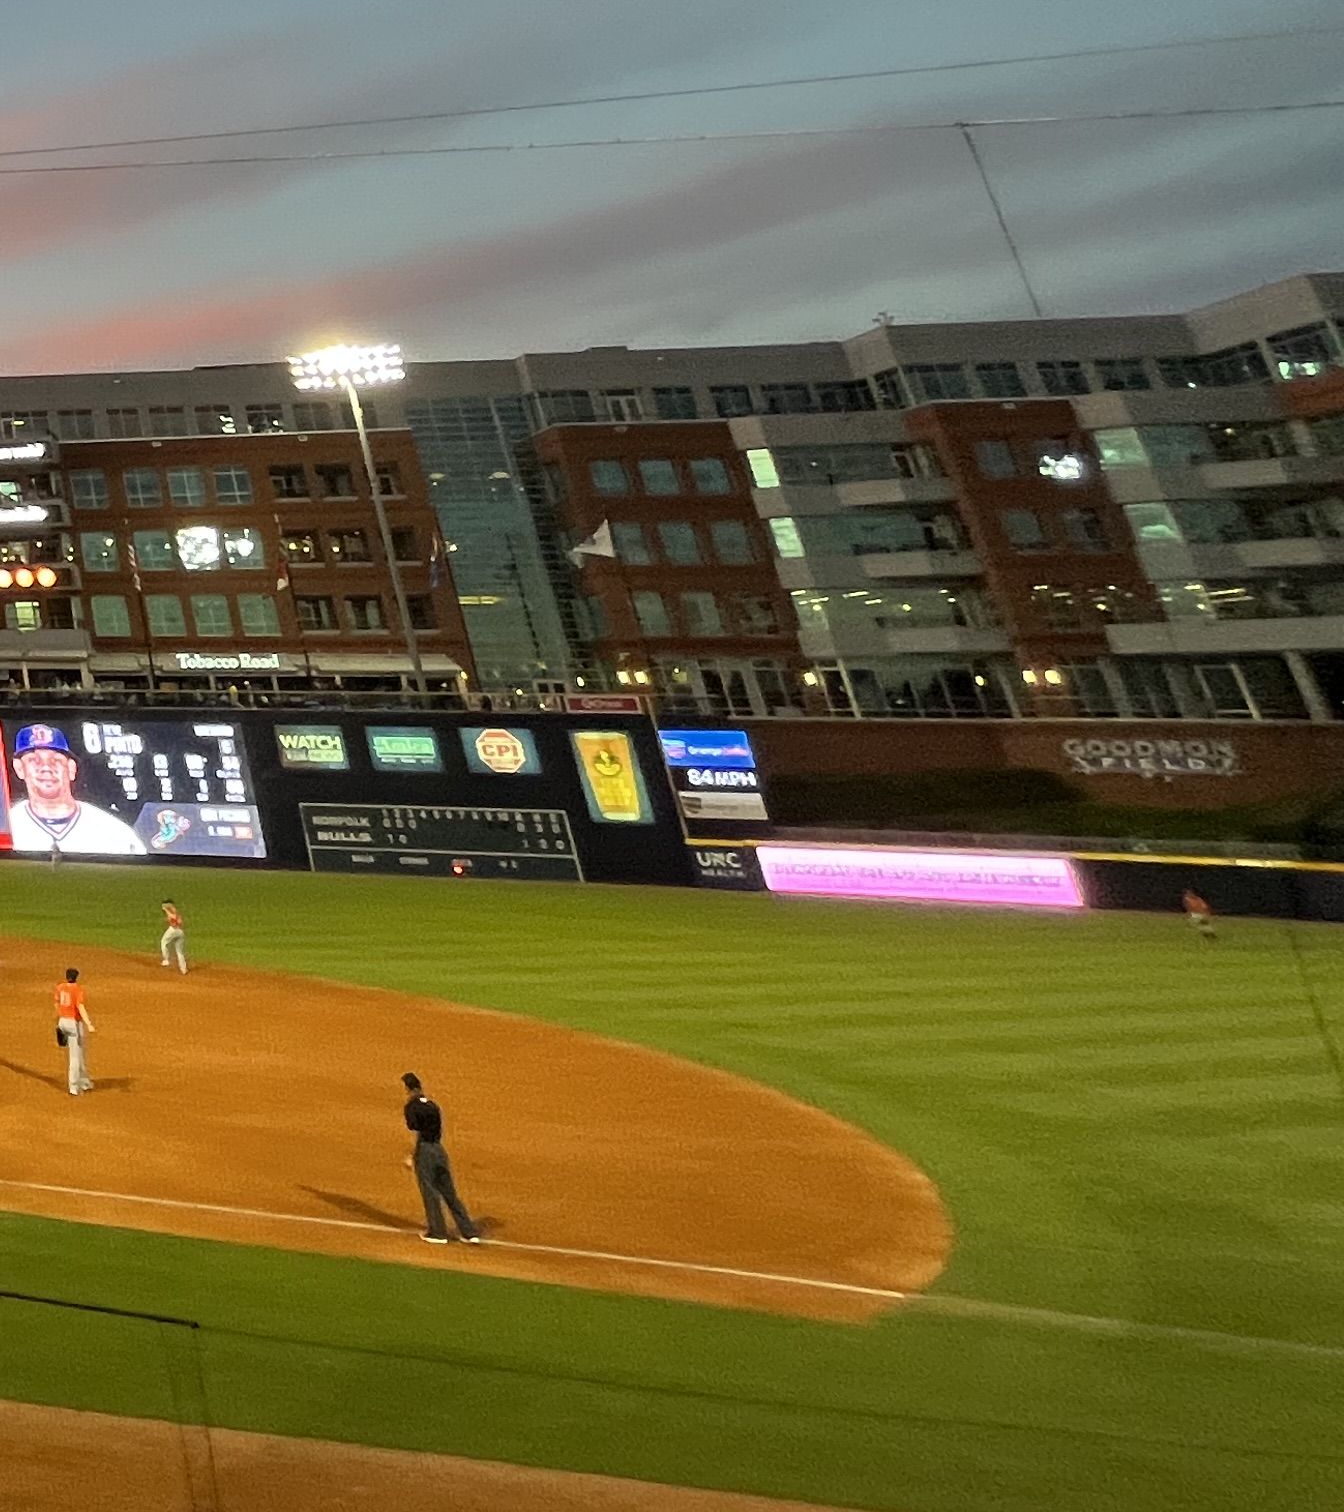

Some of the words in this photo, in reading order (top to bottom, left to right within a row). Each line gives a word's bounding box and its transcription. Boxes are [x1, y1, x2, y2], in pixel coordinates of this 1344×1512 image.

[175, 653, 239, 669] Tobacco
[238, 653, 280, 669] Road
[278, 734, 342, 749] WATCH
[481, 744, 519, 757] CPI
